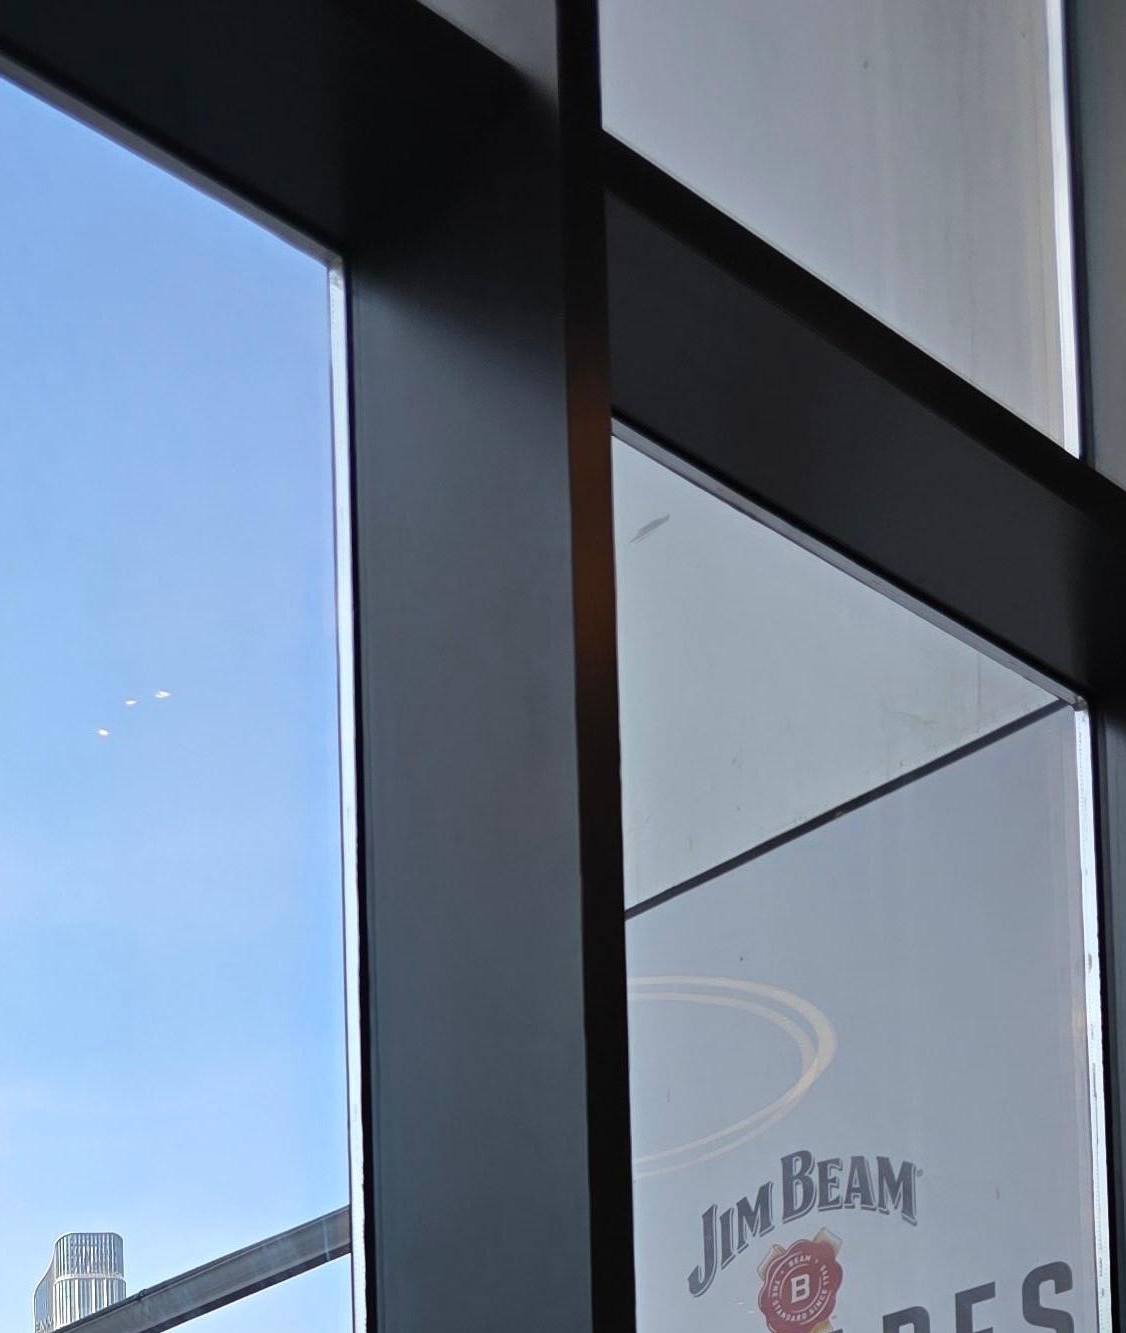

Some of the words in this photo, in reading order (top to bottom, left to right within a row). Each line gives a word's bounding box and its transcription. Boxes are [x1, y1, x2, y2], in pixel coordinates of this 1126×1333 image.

[687, 1181, 775, 1298] JIM
[780, 1150, 918, 1227] BEAM
[790, 1273, 810, 1304] B
